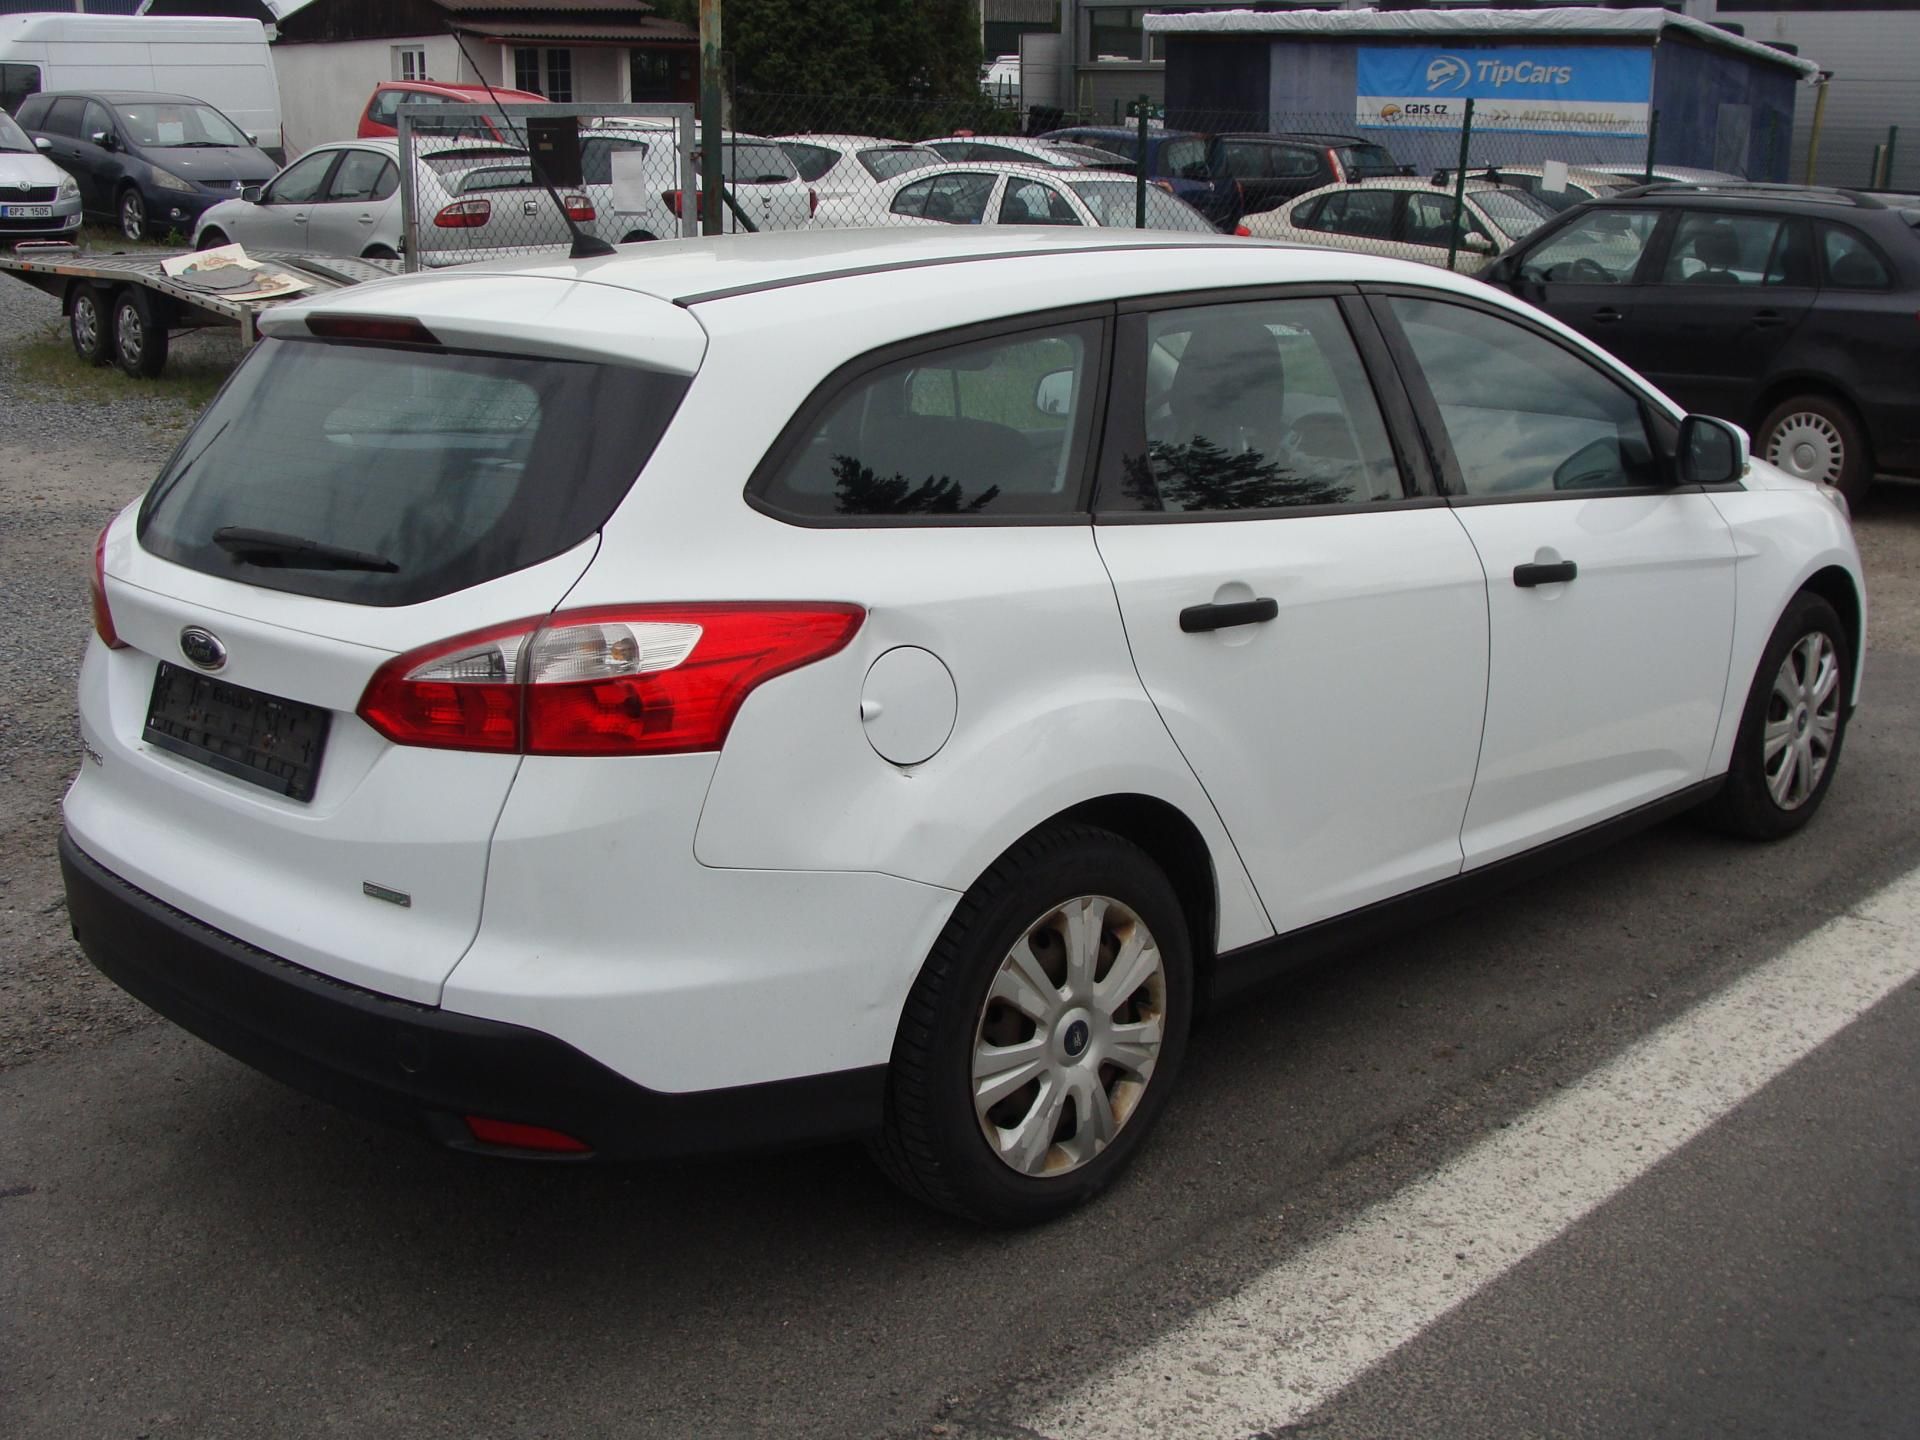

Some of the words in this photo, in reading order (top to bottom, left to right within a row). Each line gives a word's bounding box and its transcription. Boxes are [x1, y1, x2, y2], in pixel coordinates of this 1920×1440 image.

[1477, 60, 1571, 87] TipCars
[9, 207, 25, 216] 6P2
[31, 207, 49, 216] 1505
